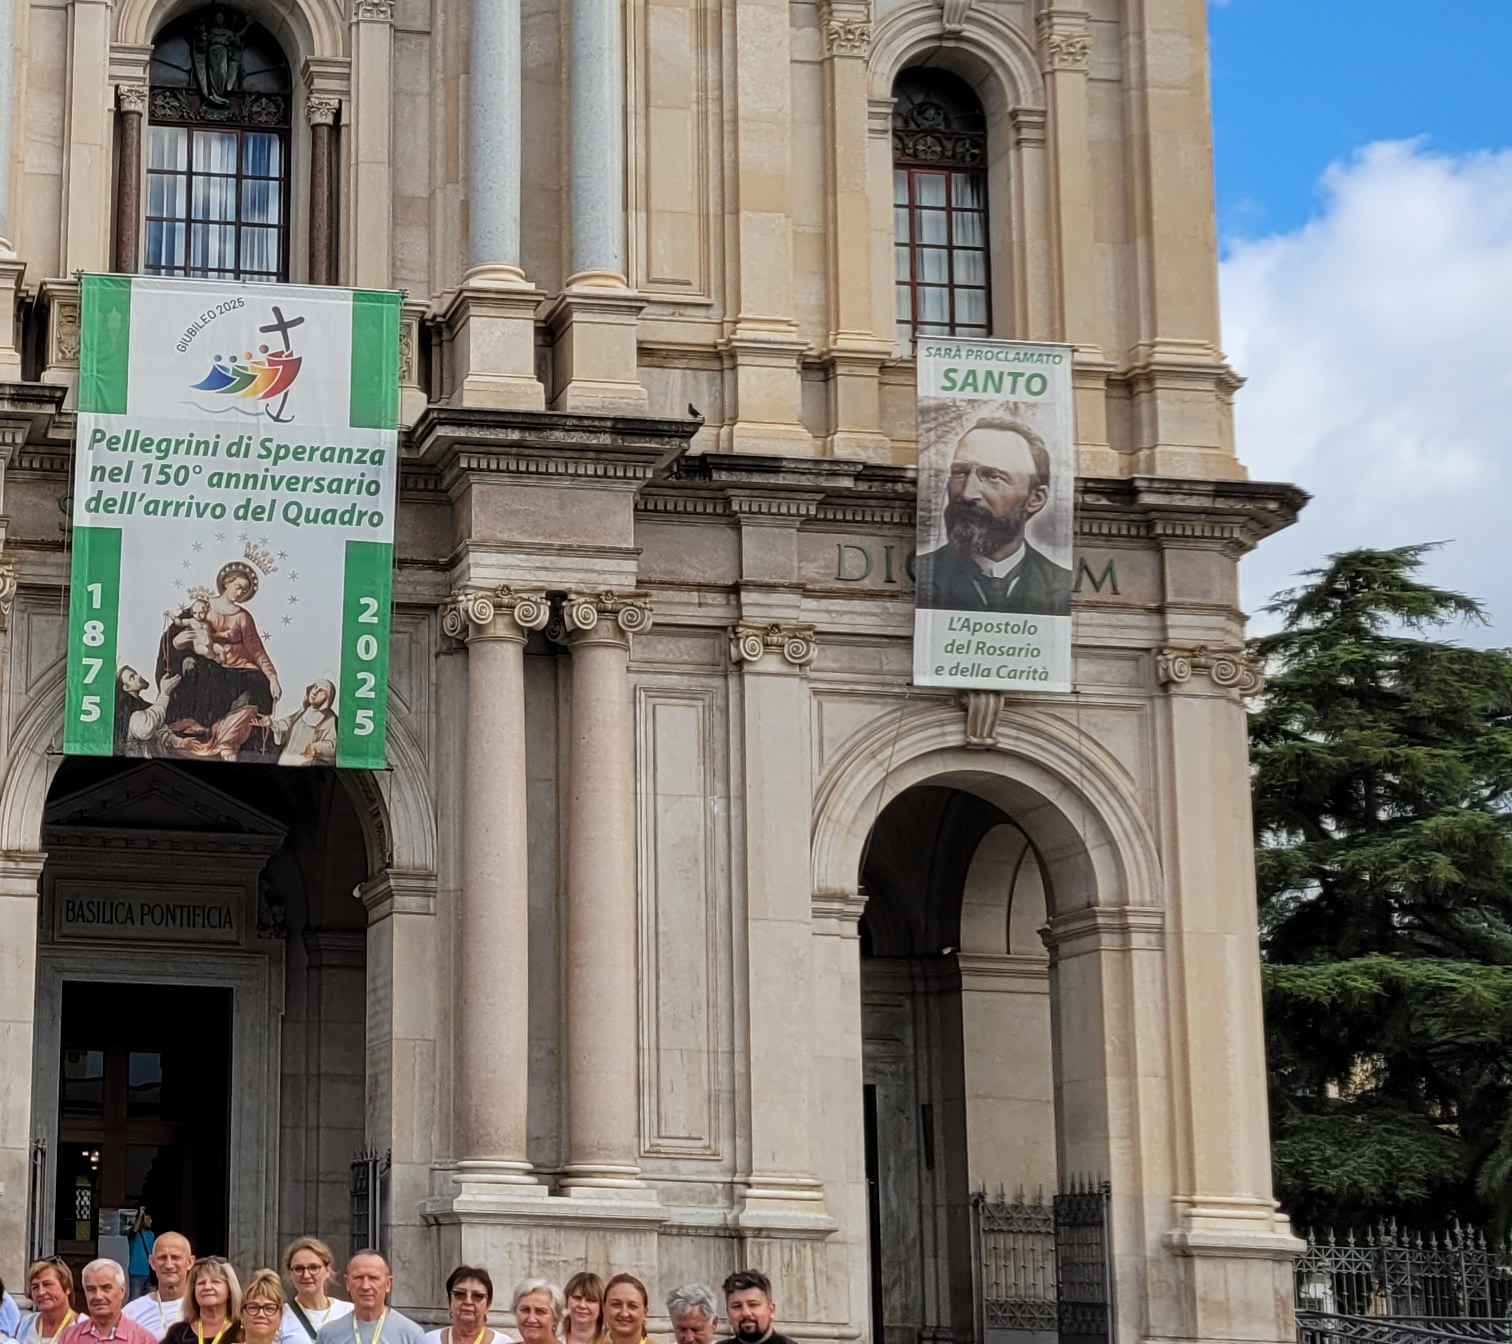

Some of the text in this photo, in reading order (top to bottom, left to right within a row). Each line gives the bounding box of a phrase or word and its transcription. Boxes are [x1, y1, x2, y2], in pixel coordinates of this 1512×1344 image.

[175, 296, 246, 354] GIUBILEO 2025
[924, 343, 1064, 366] SARÀ PROCLAMATO
[940, 367, 1049, 398] SANTO
[88, 427, 387, 467] Pellegrini di Speranza
[89, 459, 382, 497] nel 150° anniversario
[84, 489, 228, 521] dell'arrivo
[232, 497, 278, 523] del
[281, 500, 385, 529] Quadro
[947, 615, 1039, 639] L'Apostolo
[79, 582, 105, 723] 1875
[352, 596, 379, 737] 2025
[943, 639, 1041, 659] del Rosario
[934, 662, 1050, 682] e della Carità
[64, 898, 234, 931] BASILICA PONTIFICIA
